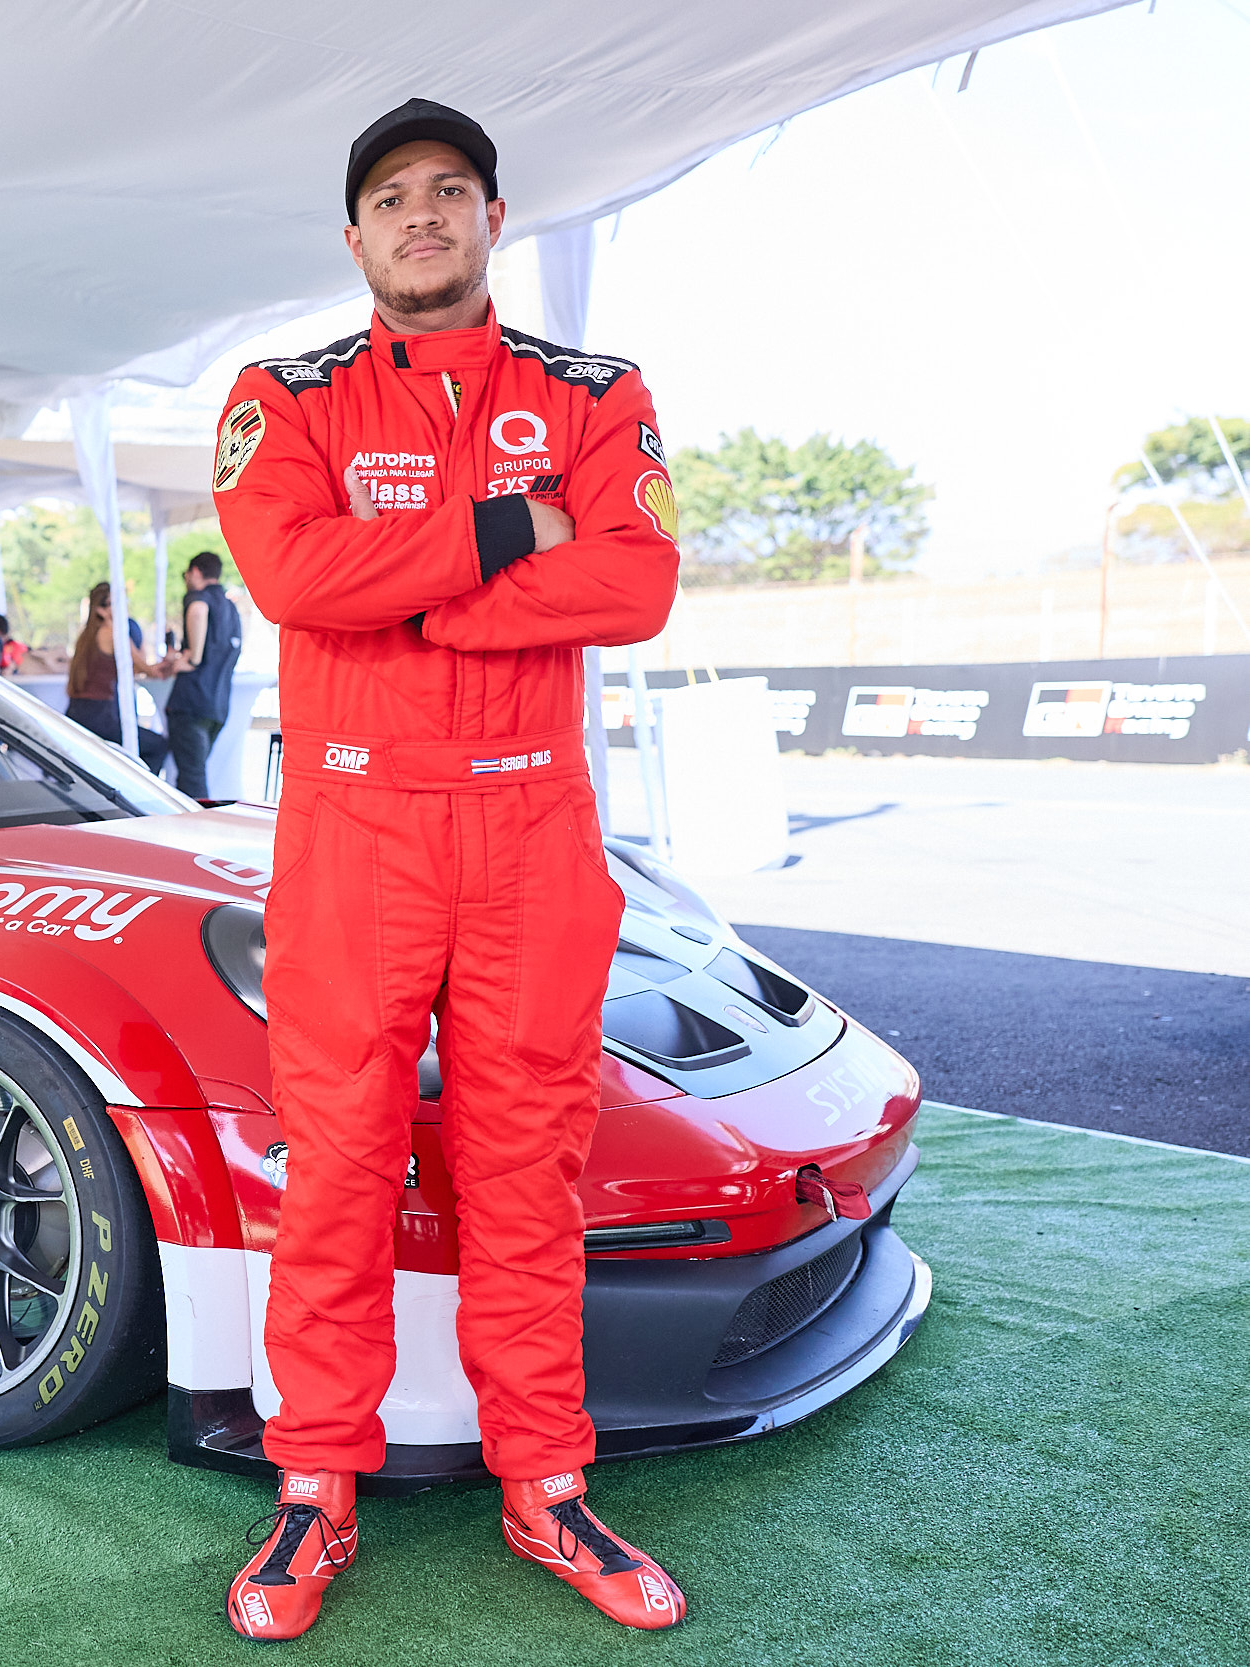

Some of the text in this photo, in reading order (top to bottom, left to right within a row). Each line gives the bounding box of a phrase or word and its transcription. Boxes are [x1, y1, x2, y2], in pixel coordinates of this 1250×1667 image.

[565, 365, 614, 380] OMP
[490, 410, 550, 455] Q
[350, 452, 436, 468] AUTOPITS
[493, 457, 552, 475] GRUPOQ
[355, 468, 435, 478] ONFIANZA PARA LLEGAR
[361, 478, 426, 502] lass
[535, 492, 564, 500] PINTURA
[394, 501, 427, 510] Refinish
[325, 748, 370, 770] OMP
[500, 750, 552, 773] SERGIO SOLIS
[5, 920, 24, 931] a
[26, 919, 71, 937] Car
[79, 1158, 95, 1180] DHF
[91, 1210, 112, 1253] P
[37, 1261, 110, 1406] ZERO
[287, 1479, 319, 1495] OMP
[543, 1473, 574, 1494] OMP
[643, 1575, 670, 1611] OMP
[243, 1592, 269, 1628] OMP
